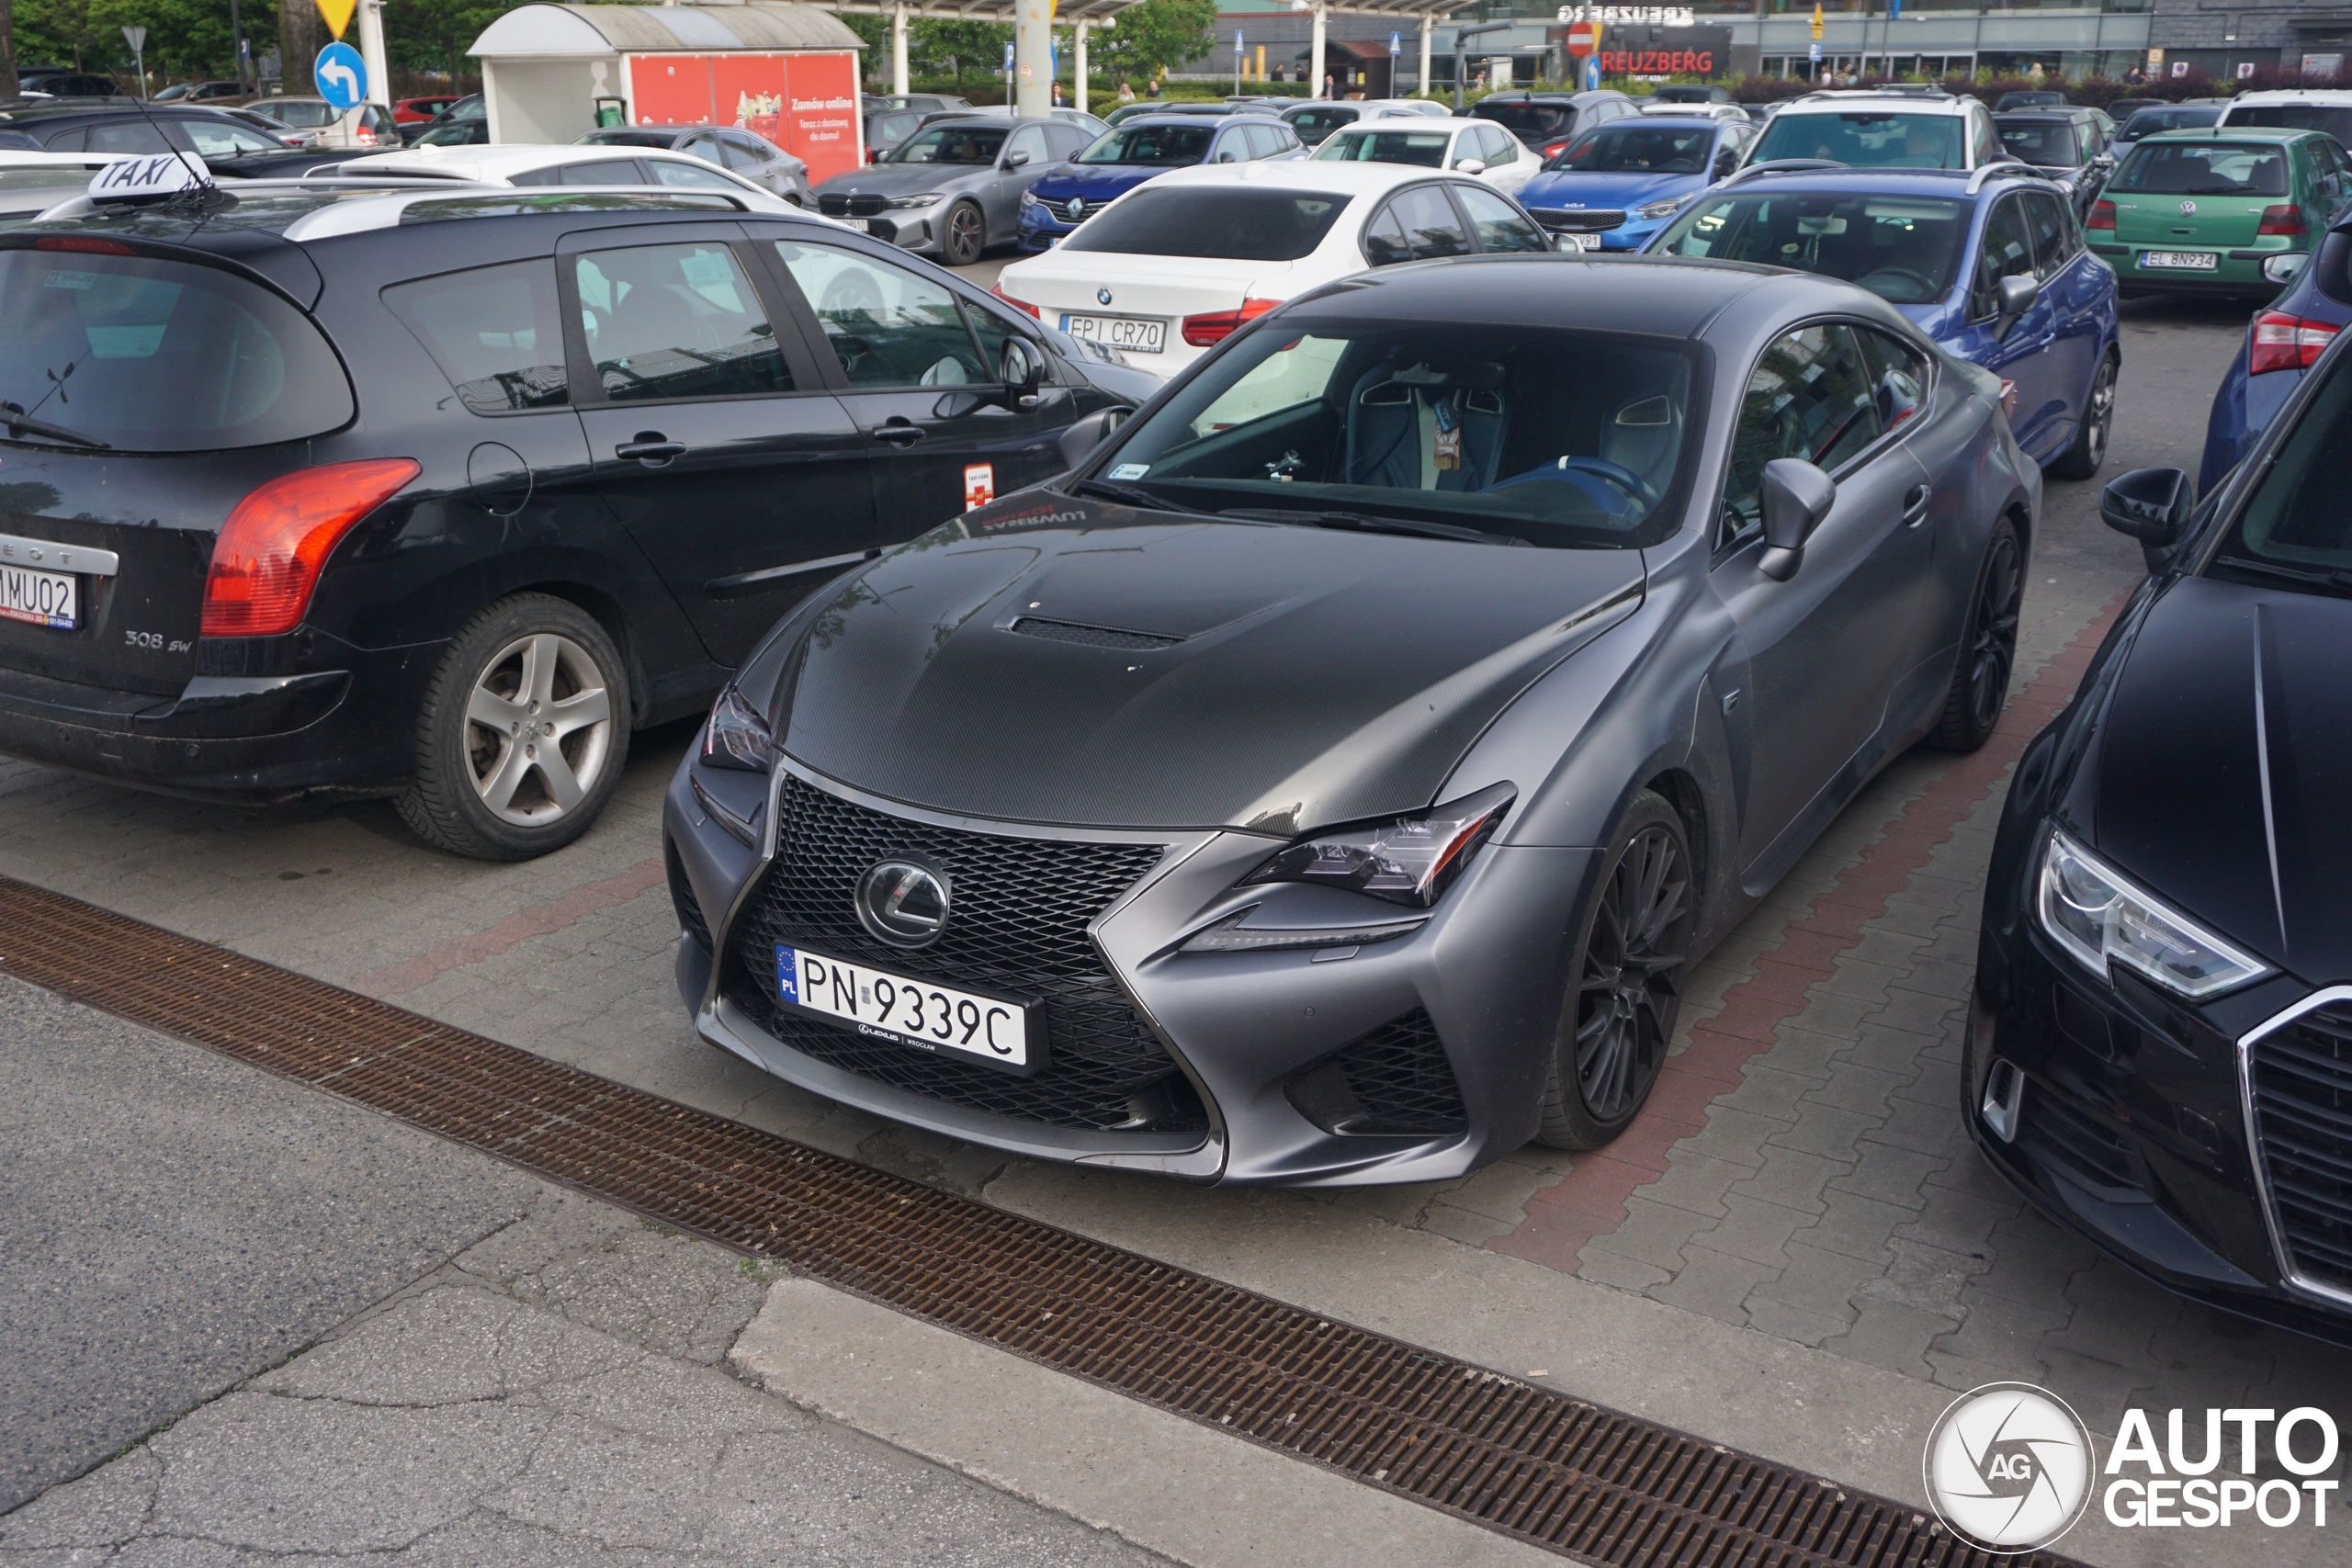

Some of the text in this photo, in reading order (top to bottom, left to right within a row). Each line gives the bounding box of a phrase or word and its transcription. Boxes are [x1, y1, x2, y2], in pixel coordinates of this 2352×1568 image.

[1591, 51, 1713, 72] REUZBERG
[791, 96, 854, 110] Zamów online
[798, 119, 817, 129] Teraz
[821, 118, 849, 129] dostawą
[809, 130, 840, 141] do domu!
[101, 157, 176, 188] TAXI
[1112, 321, 1159, 346] CR70
[125, 630, 164, 649] 308
[782, 978, 797, 995] PL
[868, 1028, 936, 1052] LEXUS WROCŁAW
